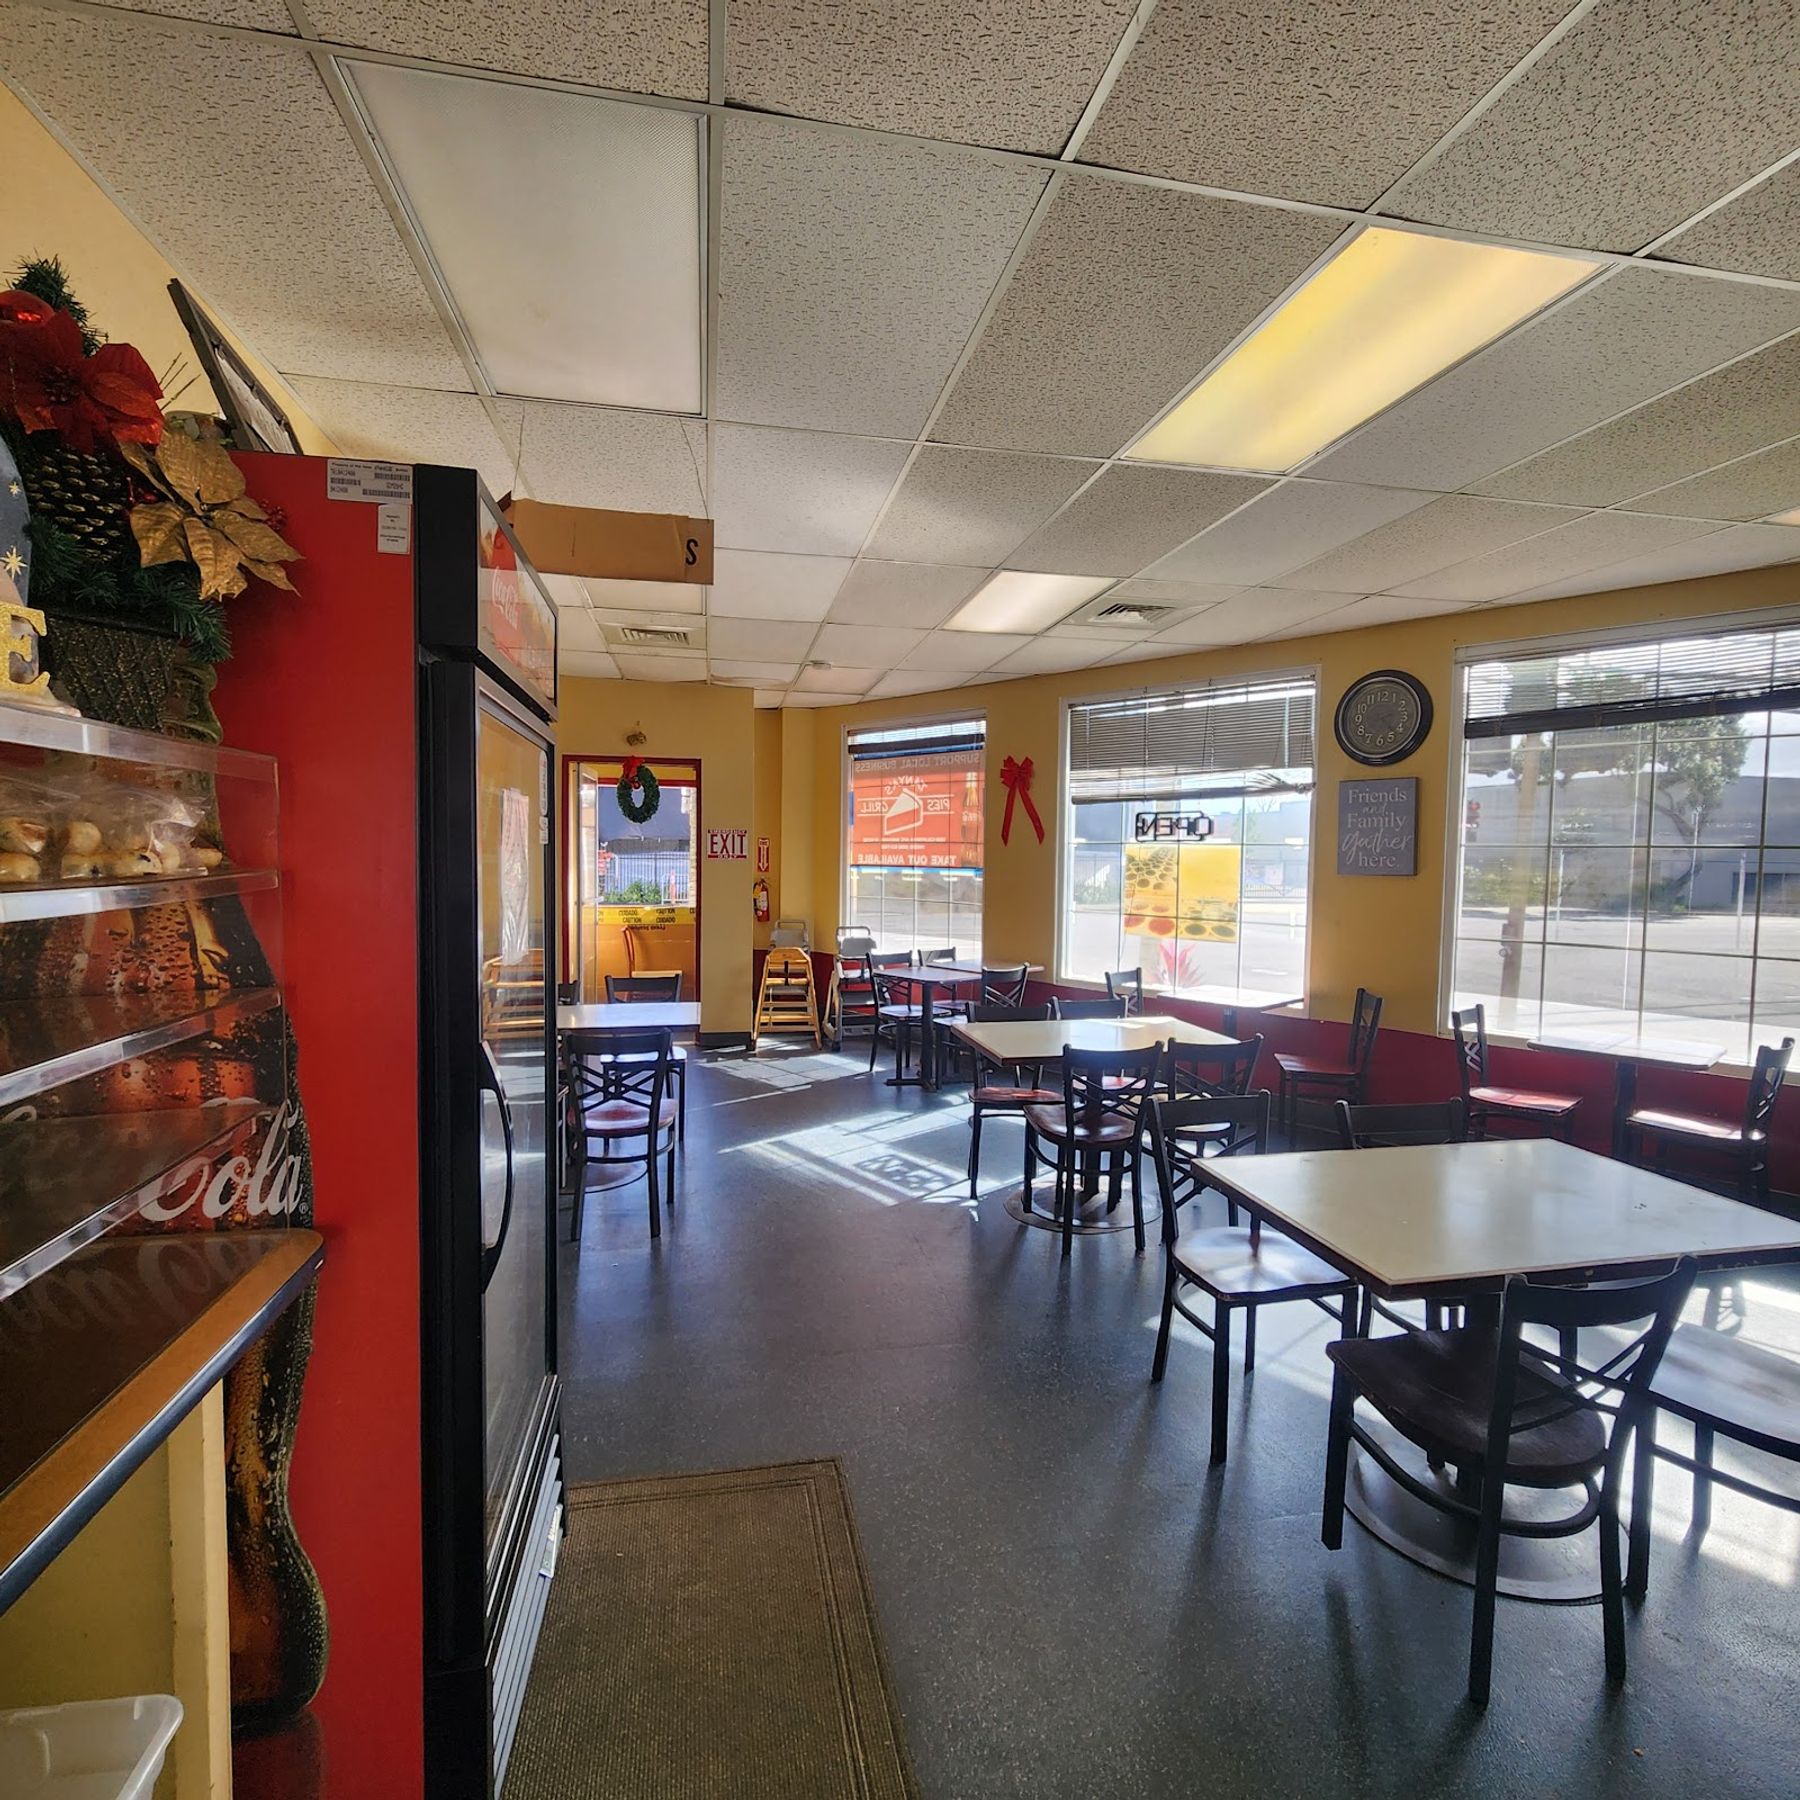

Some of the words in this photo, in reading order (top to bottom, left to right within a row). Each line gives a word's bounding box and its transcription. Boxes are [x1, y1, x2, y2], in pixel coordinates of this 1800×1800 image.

[685, 538, 699, 566] S
[1367, 694, 1375, 704] 11
[1377, 691, 1389, 701] 12
[1357, 703, 1367, 714] 10
[1398, 700, 1406, 711] 2
[1355, 715, 1362, 725] 9
[1400, 712, 1408, 722] 3
[1357, 725, 1365, 736] 8
[1397, 723, 1404, 732] 4
[1365, 733, 1373, 743] 7
[1376, 735, 1384, 746] 6
[1387, 732, 1395, 742] 5
[1348, 786, 1408, 804] Friends
[1362, 802, 1388, 816] and
[1347, 812, 1407, 832] Family
[710, 834, 746, 854] EXIT
[1359, 851, 1400, 867] here.
